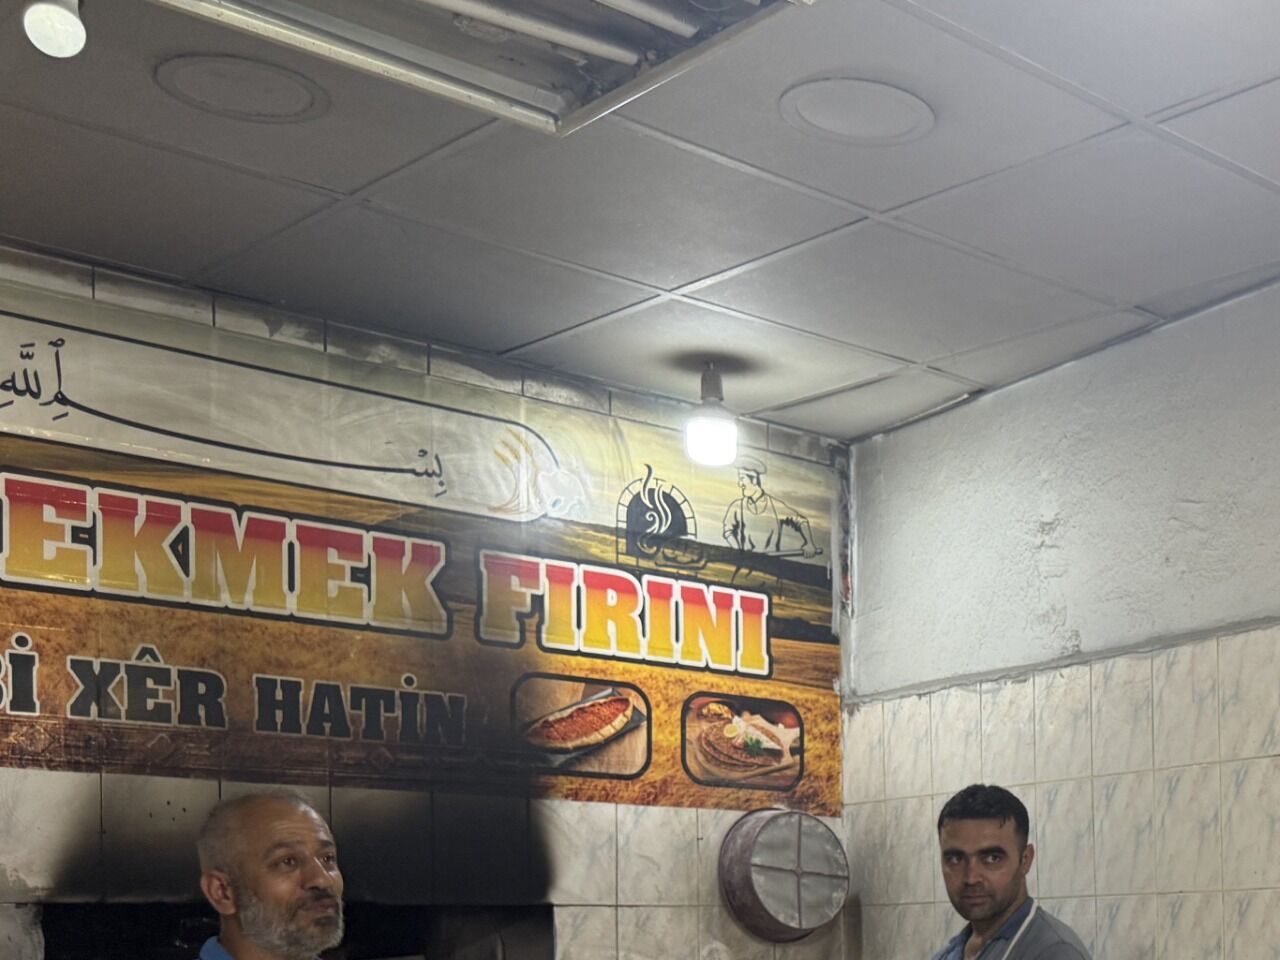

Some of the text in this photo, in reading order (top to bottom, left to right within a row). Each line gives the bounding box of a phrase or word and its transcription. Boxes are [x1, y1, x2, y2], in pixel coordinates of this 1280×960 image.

[1, 472, 770, 677] EKMEK FIRINI
[0, 632, 467, 746] İ XÊR HATİN
